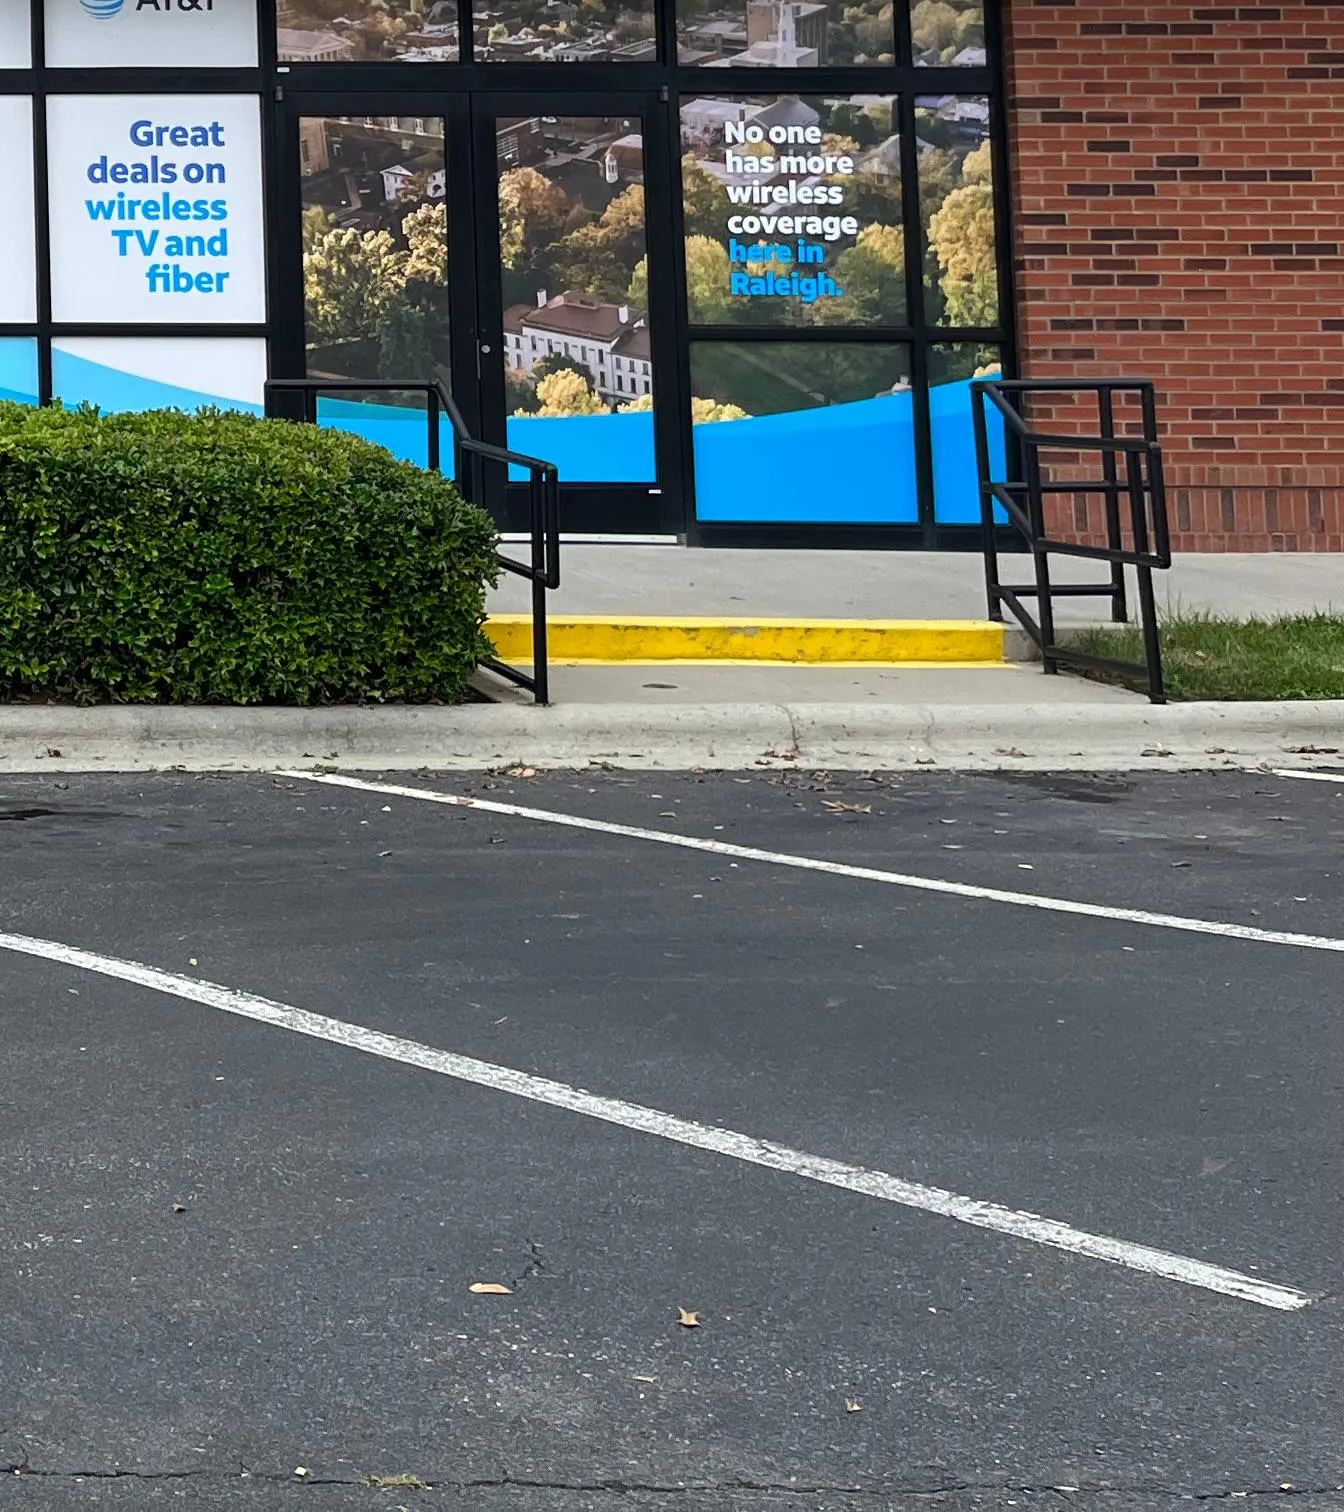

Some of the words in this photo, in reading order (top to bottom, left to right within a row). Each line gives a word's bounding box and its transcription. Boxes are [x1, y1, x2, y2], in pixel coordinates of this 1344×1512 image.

[129, 120, 225, 147] Great
[724, 121, 764, 144] No
[768, 125, 822, 144] one
[86, 156, 176, 184] deals
[183, 164, 226, 184] on
[725, 149, 775, 174] has
[780, 155, 854, 174] more
[726, 180, 844, 205] wireless
[85, 192, 227, 221] wireless
[727, 215, 858, 241] coverage
[111, 229, 160, 257] TV
[165, 228, 229, 257] and
[729, 238, 793, 263] here
[797, 239, 825, 263] in
[145, 264, 230, 293] fiber
[730, 272, 844, 304] Raleigh.
